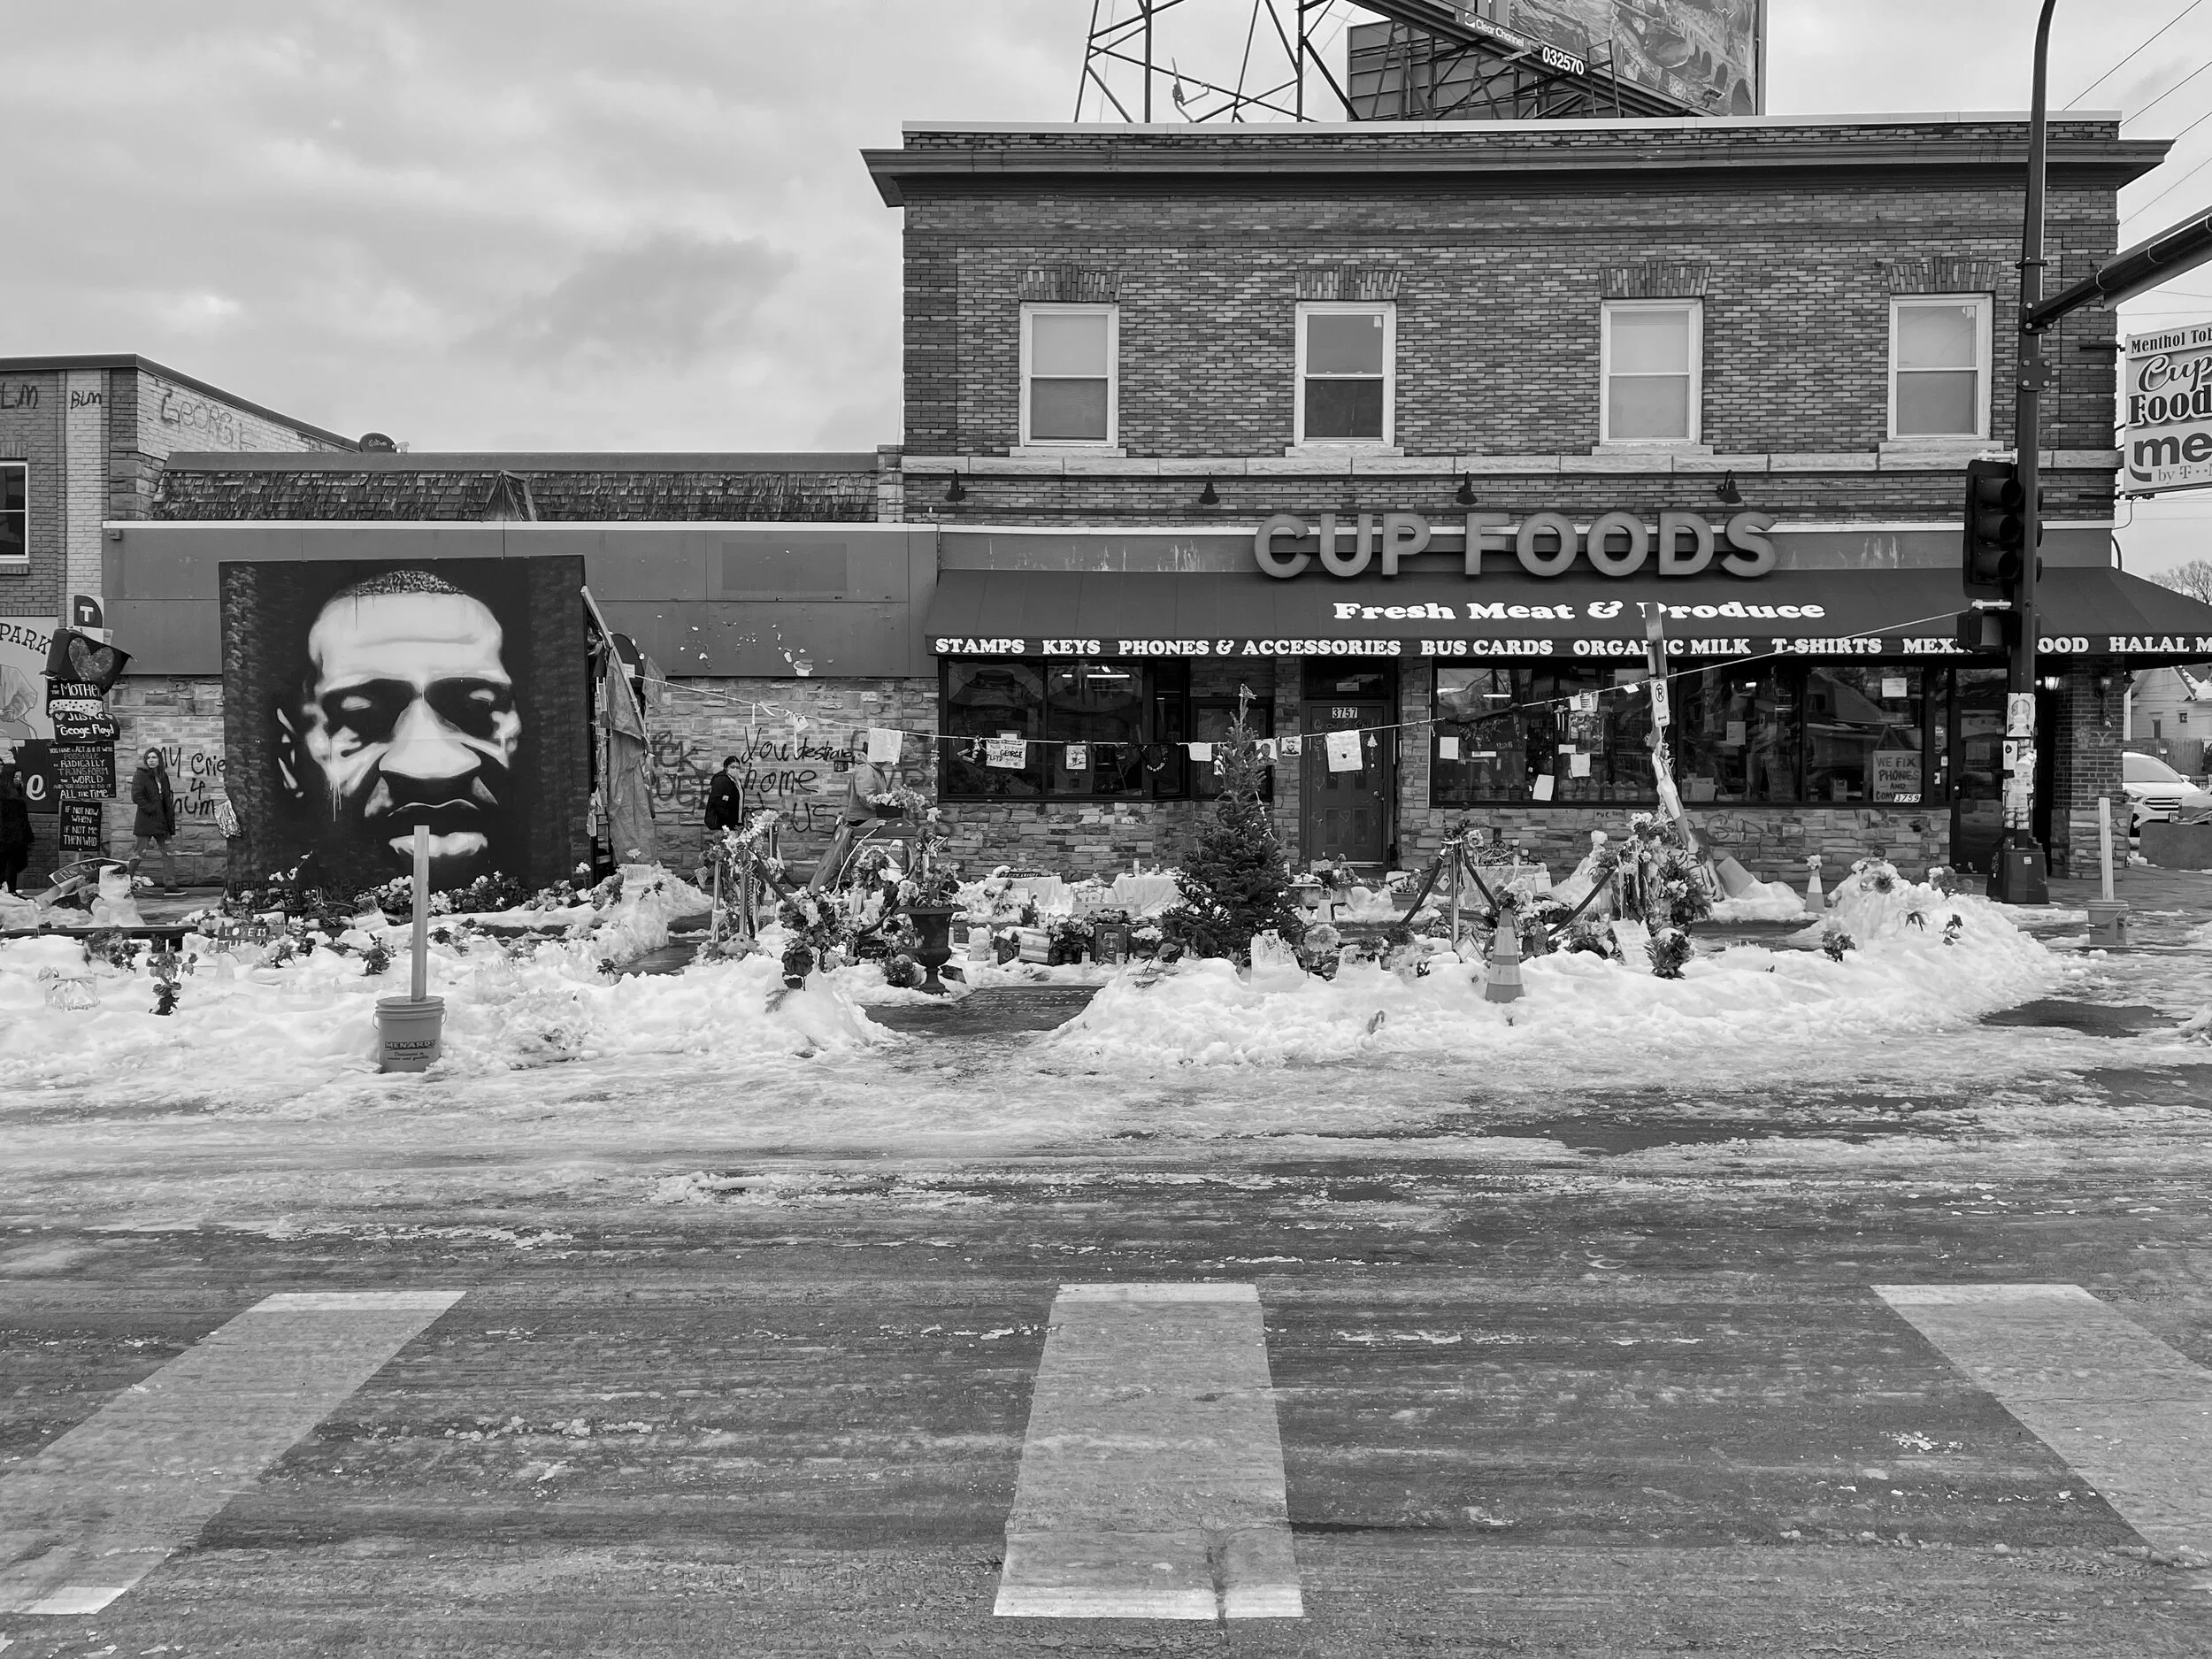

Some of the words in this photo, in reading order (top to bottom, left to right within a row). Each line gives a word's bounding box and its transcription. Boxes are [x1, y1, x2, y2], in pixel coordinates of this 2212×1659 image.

[1476, 19, 1495, 35] Clear
[1495, 27, 1525, 48] Channel
[1542, 46, 1584, 75] 032570
[2131, 331, 2185, 354] Menthol
[2139, 355, 2212, 392] Cup
[70, 390, 102, 409] BLM
[2158, 469, 2175, 484] by
[1254, 513, 1432, 579] CUP
[1464, 511, 1777, 579] FOODS
[1333, 601, 1455, 619] Fresh
[1466, 601, 1575, 619] Meat
[1587, 600, 1624, 618] &
[0, 622, 52, 655] PARK
[934, 638, 1025, 655] STAMPS
[1041, 639, 1101, 655] KEYS
[1118, 639, 1210, 655] PHONES
[1216, 639, 1235, 655] &
[1241, 639, 1402, 655] ACCESSORIES
[1420, 640, 1467, 656] BUS
[1472, 639, 1554, 656] CARDS
[1573, 639, 1684, 656] ORGAC
[1690, 638, 1751, 655] MILK
[1771, 637, 1883, 655] T-SHIRTS
[2108, 636, 2190, 653] HALAL
[60, 683, 100, 697] MOTHE
[1333, 708, 1357, 718] 3757
[1000, 749, 1023, 758] GEORGE
[1876, 757, 1892, 767] WE
[1895, 757, 1916, 768] FIX
[72, 775, 104, 784] WORLD
[743, 762, 819, 796] home
[1878, 769, 1920, 781] PHONES
[59, 789, 76, 799] ALL
[72, 826, 86, 834] NOT
[64, 834, 82, 846] THEN
[82, 835, 97, 847] WHO
